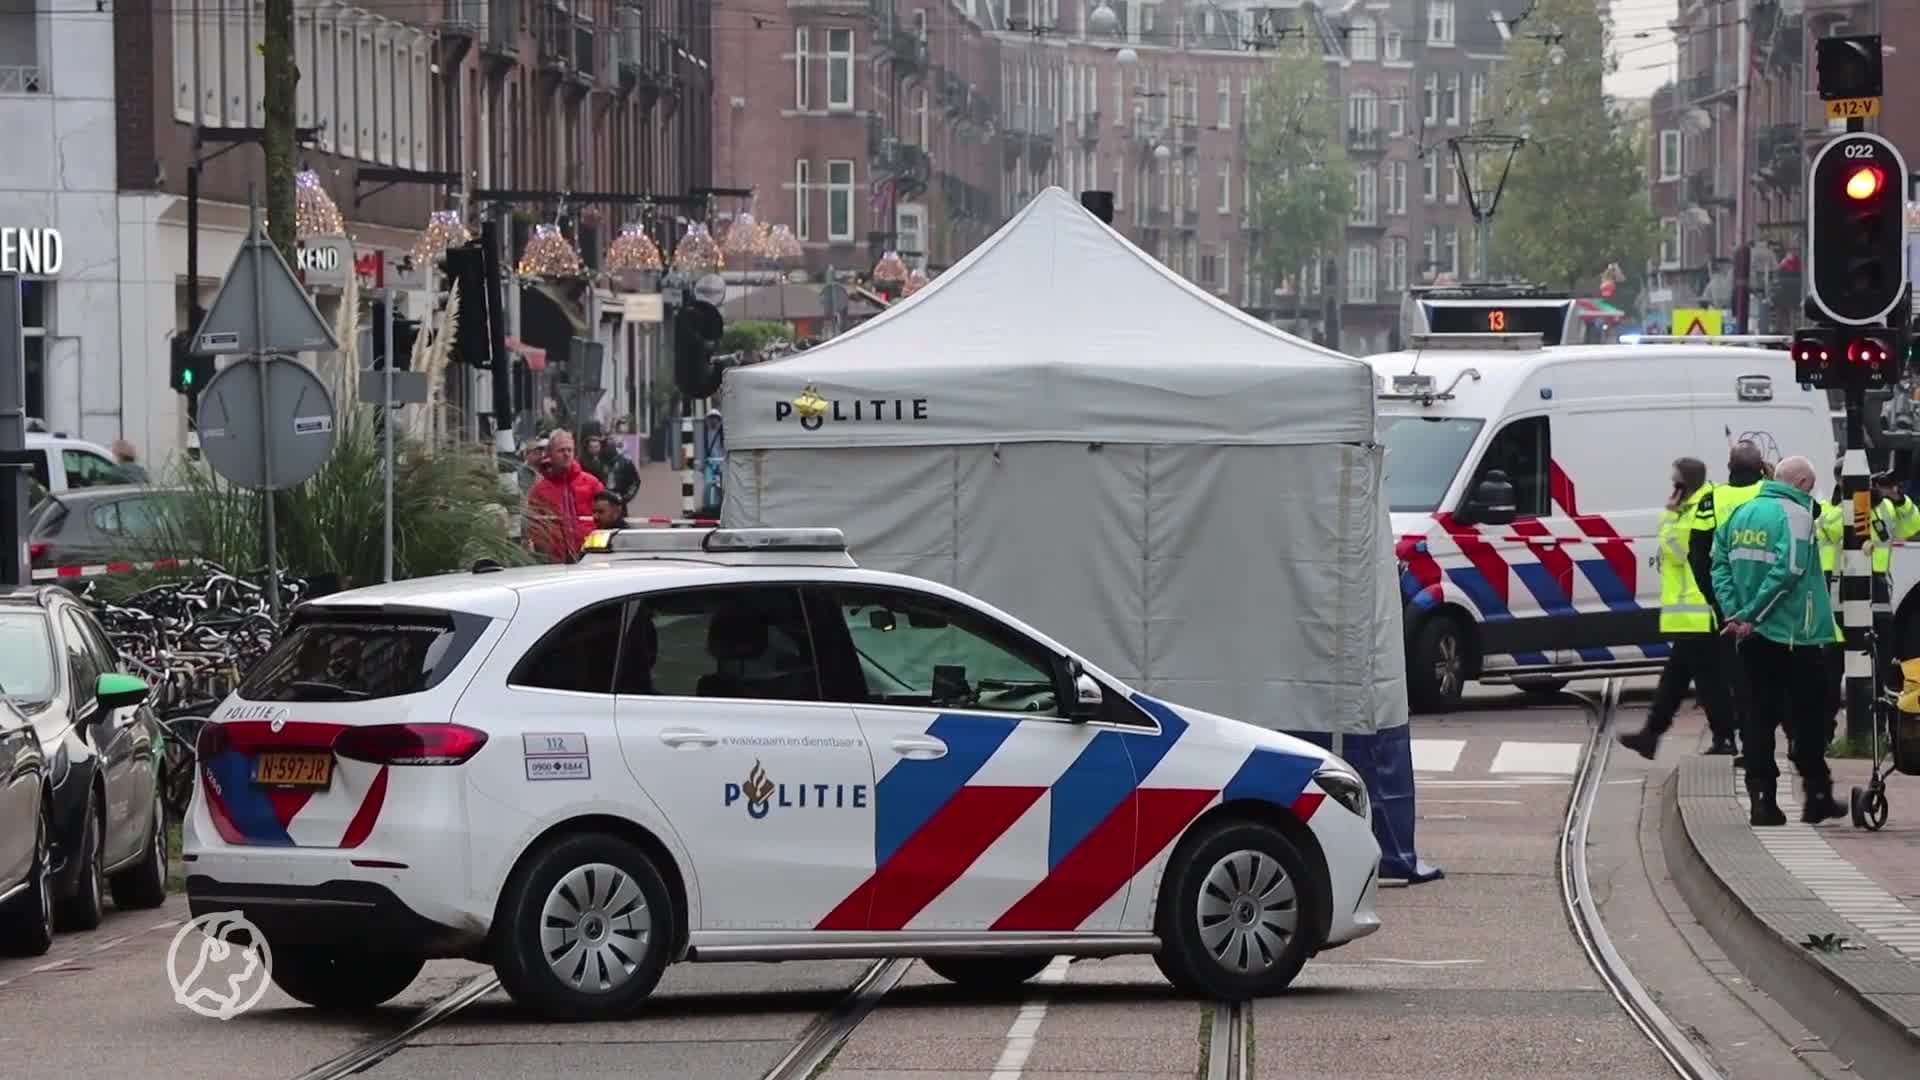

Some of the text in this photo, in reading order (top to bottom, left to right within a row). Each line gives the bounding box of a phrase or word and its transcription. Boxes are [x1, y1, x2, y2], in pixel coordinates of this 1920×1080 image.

[1844, 144, 1874, 159] 022
[1, 227, 63, 274] END
[1487, 310, 1505, 331] 13
[546, 737, 566, 750] 112
[262, 757, 326, 781] N-597-JR
[724, 782, 867, 819] POLITIE
